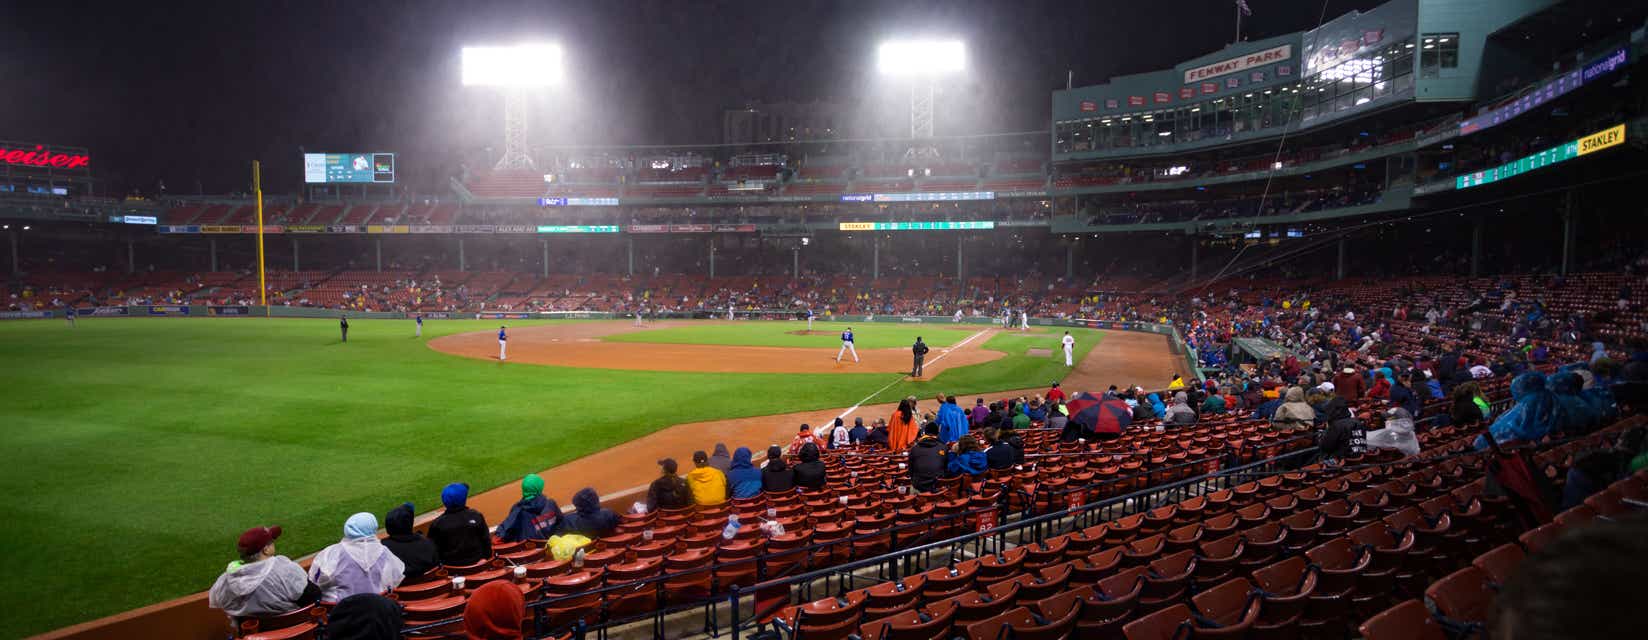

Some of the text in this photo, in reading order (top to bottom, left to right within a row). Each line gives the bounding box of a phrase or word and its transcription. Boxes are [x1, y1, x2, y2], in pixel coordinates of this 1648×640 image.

[1190, 49, 1283, 80] FENWAY PARK
[1582, 130, 1620, 152] STANLEY
